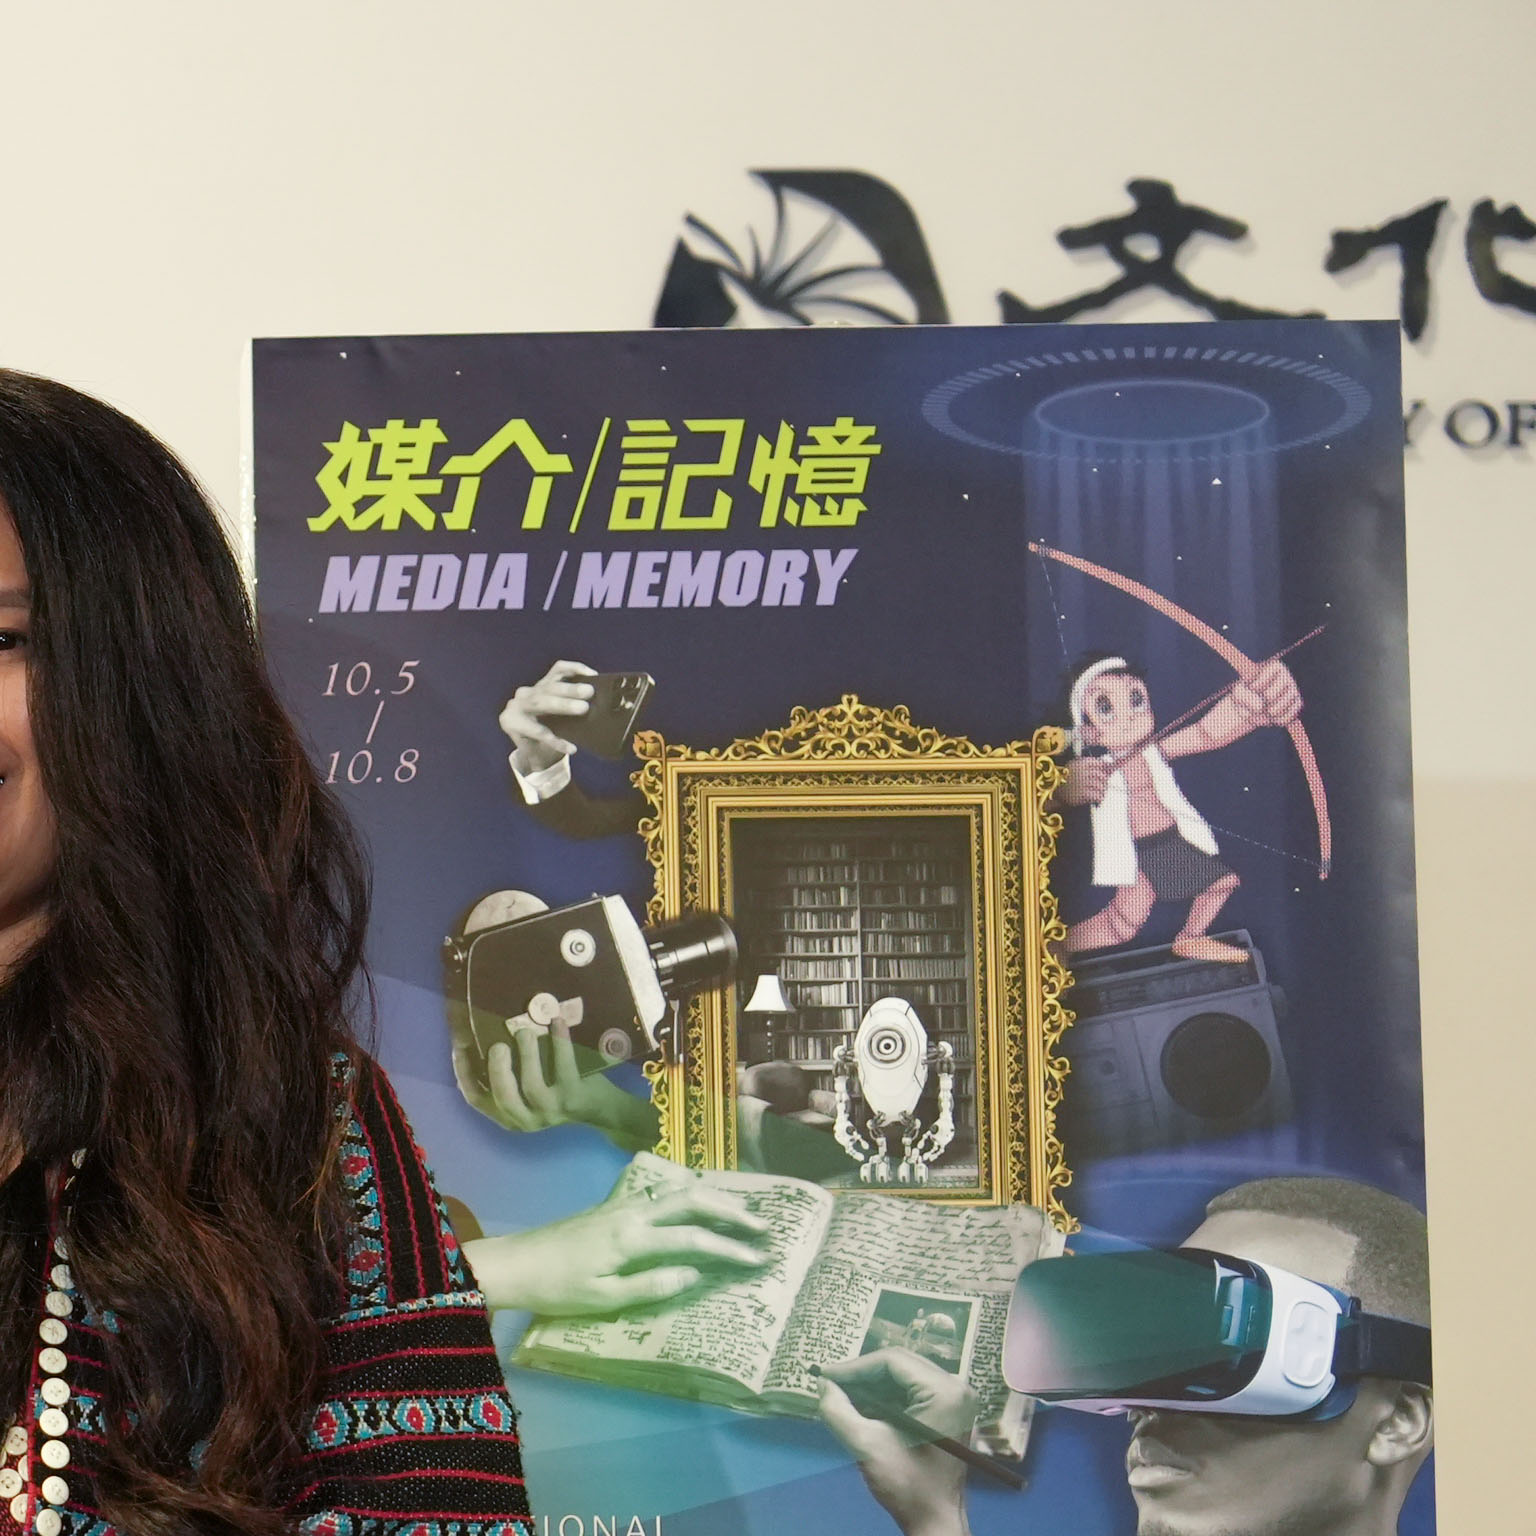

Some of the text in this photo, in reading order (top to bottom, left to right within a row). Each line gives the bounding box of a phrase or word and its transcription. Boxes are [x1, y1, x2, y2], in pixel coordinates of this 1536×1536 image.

[318, 552, 528, 614] MEDIA
[571, 548, 859, 610] MEMORY
[321, 660, 420, 697] 10.5
[324, 748, 419, 785] 10.8
